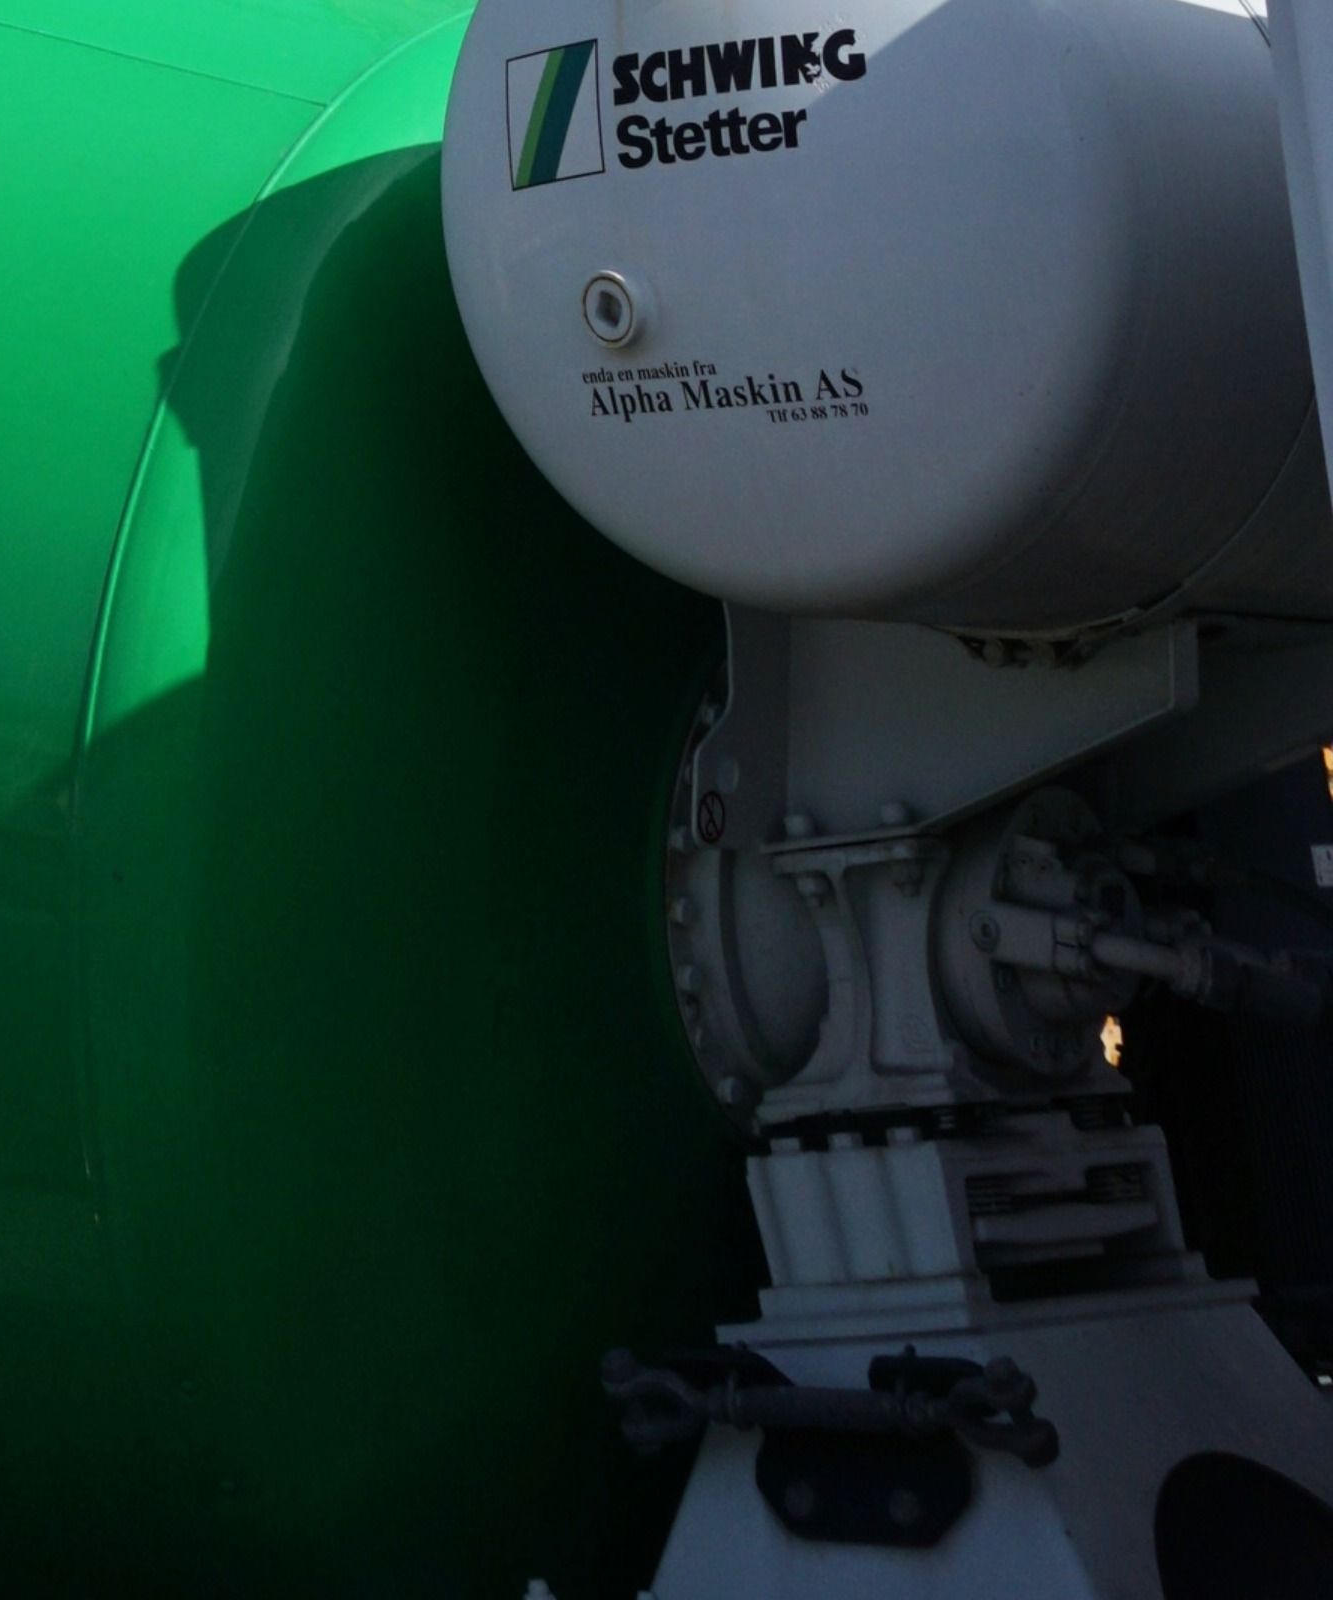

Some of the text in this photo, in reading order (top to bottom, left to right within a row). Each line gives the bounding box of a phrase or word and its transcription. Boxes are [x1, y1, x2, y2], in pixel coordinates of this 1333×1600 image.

[616, 107, 807, 169] Stetter
[582, 360, 717, 384] enda en maskin fra
[591, 368, 863, 422] Alpha Maskin AS
[791, 407, 808, 421] 63
[810, 406, 828, 419] 88
[830, 404, 848, 418] 78
[850, 403, 869, 416] 70
